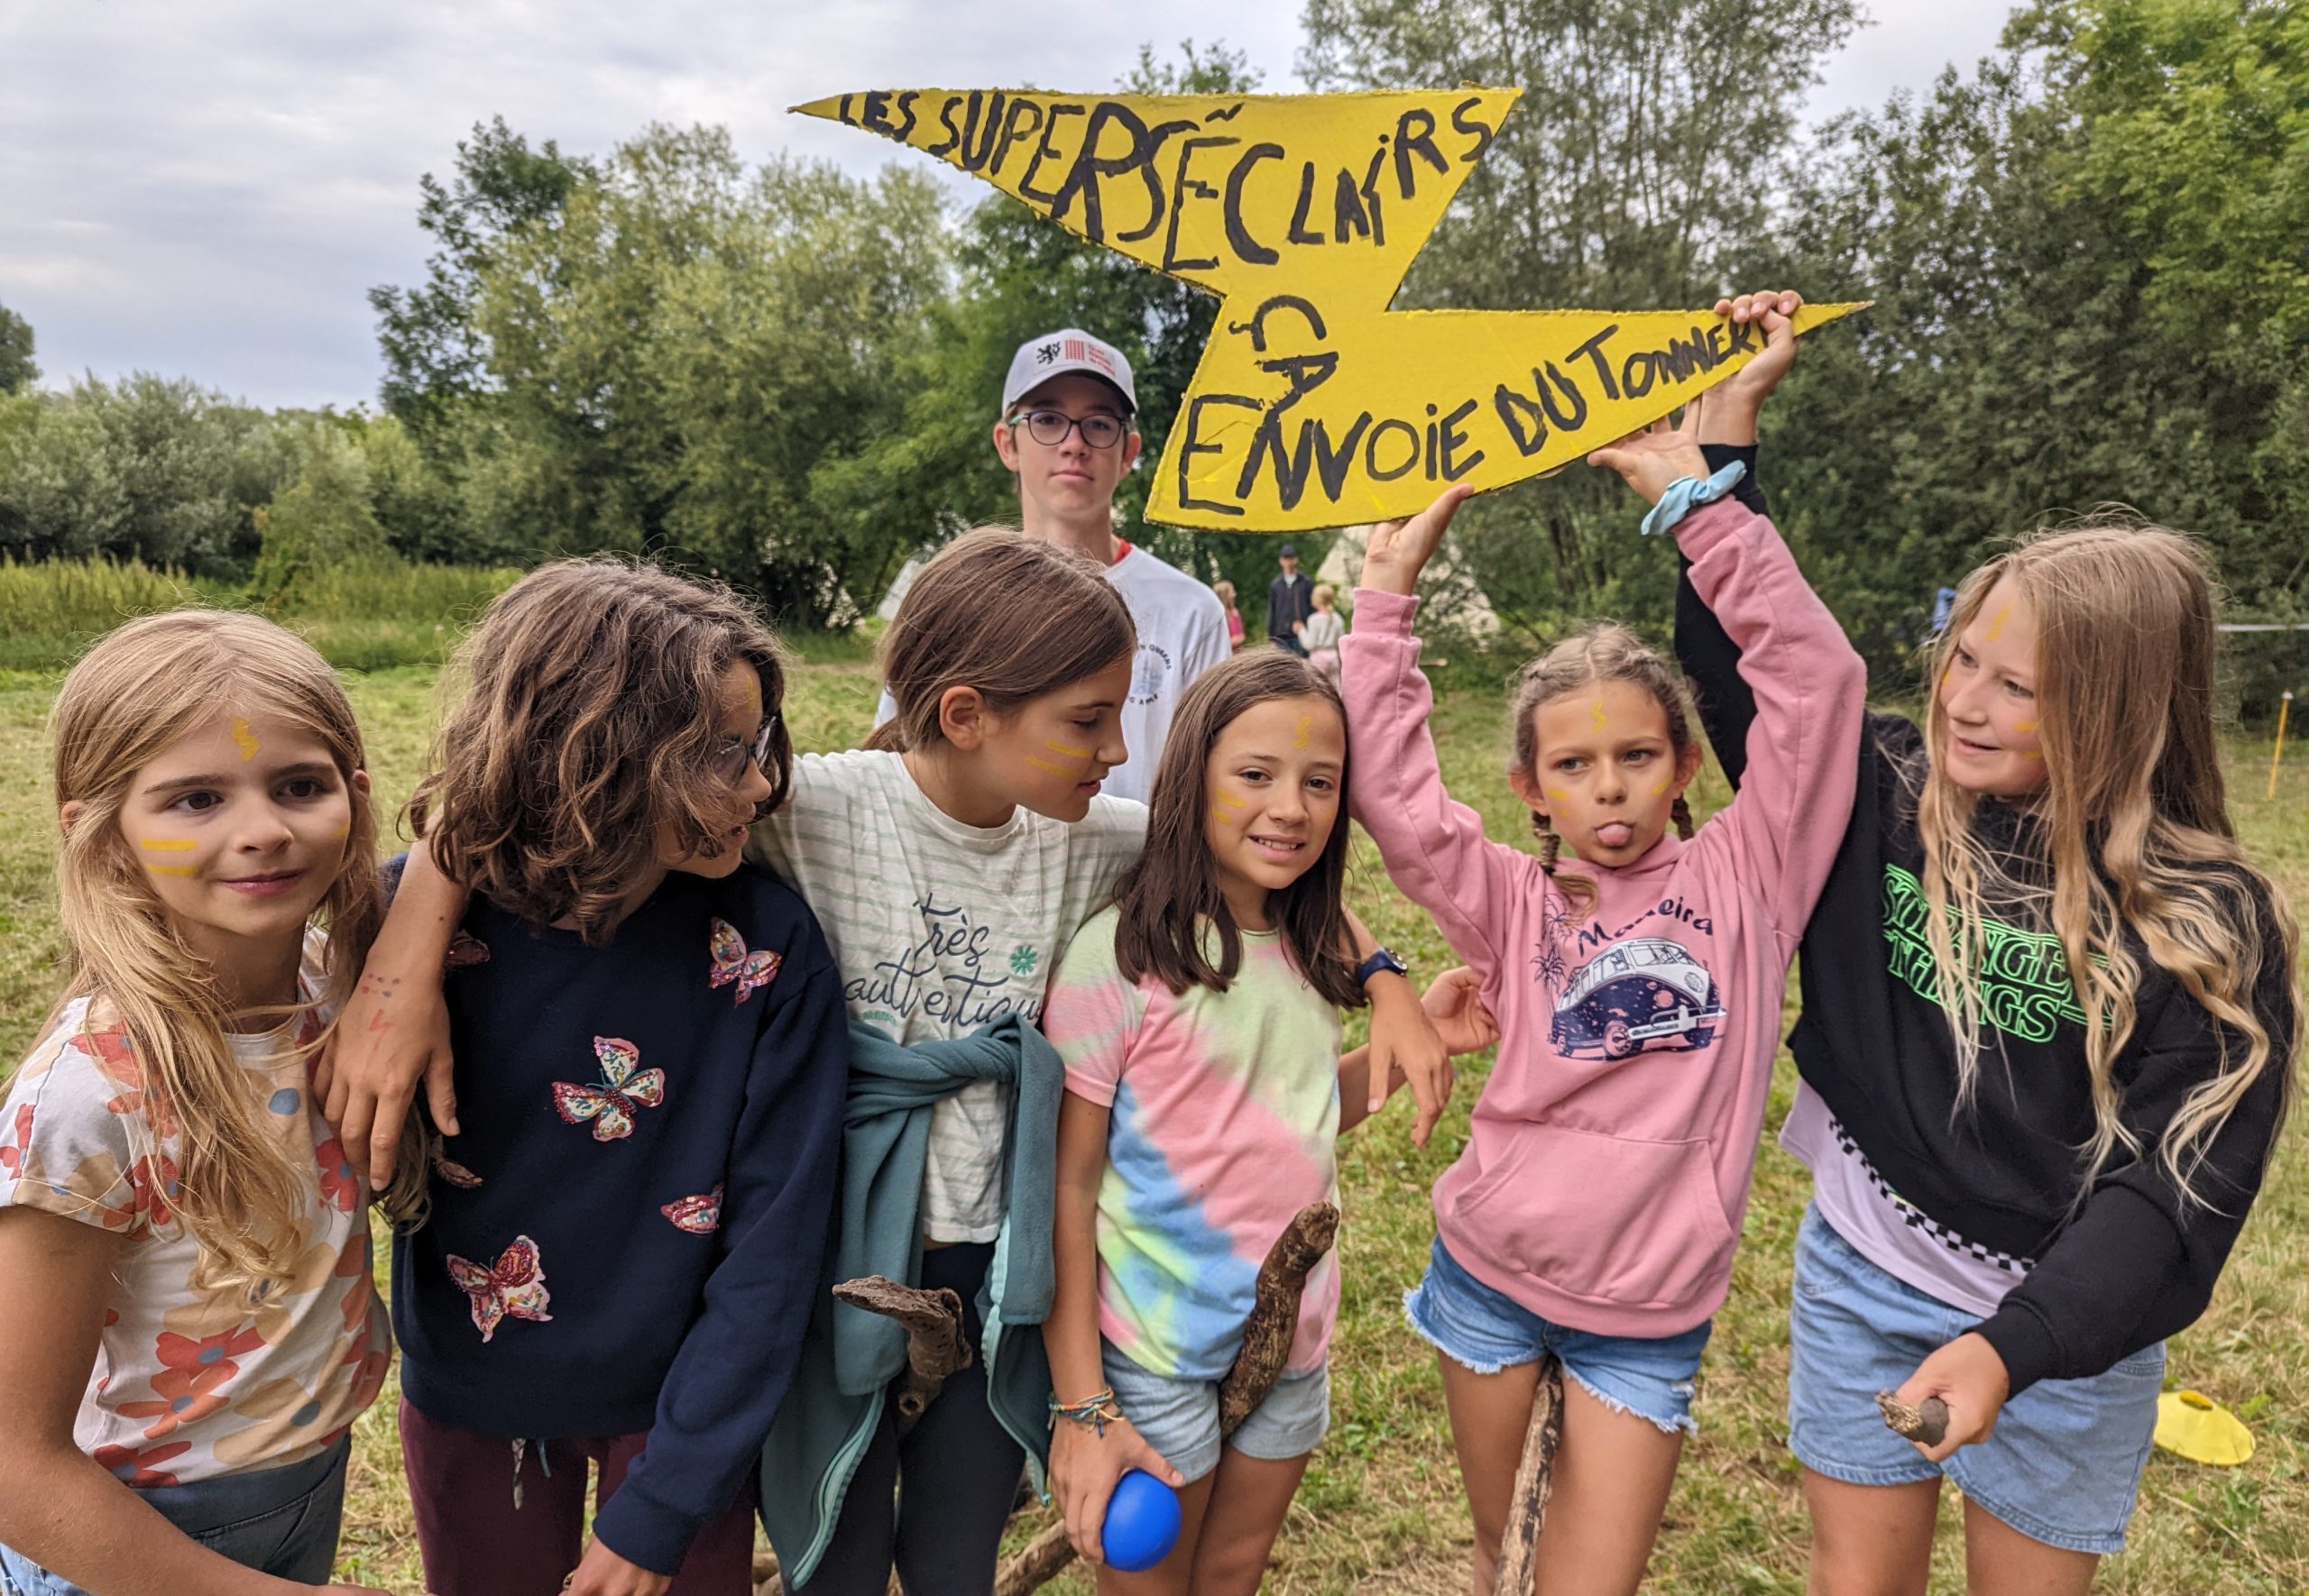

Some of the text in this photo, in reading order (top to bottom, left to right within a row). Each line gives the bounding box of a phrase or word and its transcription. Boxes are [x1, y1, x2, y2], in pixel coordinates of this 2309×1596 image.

[839, 91, 920, 138] LES
[1495, 360, 1587, 457] DU
[1565, 315, 1769, 400] TONNER
[912, 892, 989, 968] très
[844, 941, 1042, 1027] authentiqu
[1882, 930, 2063, 1043] THNGS
